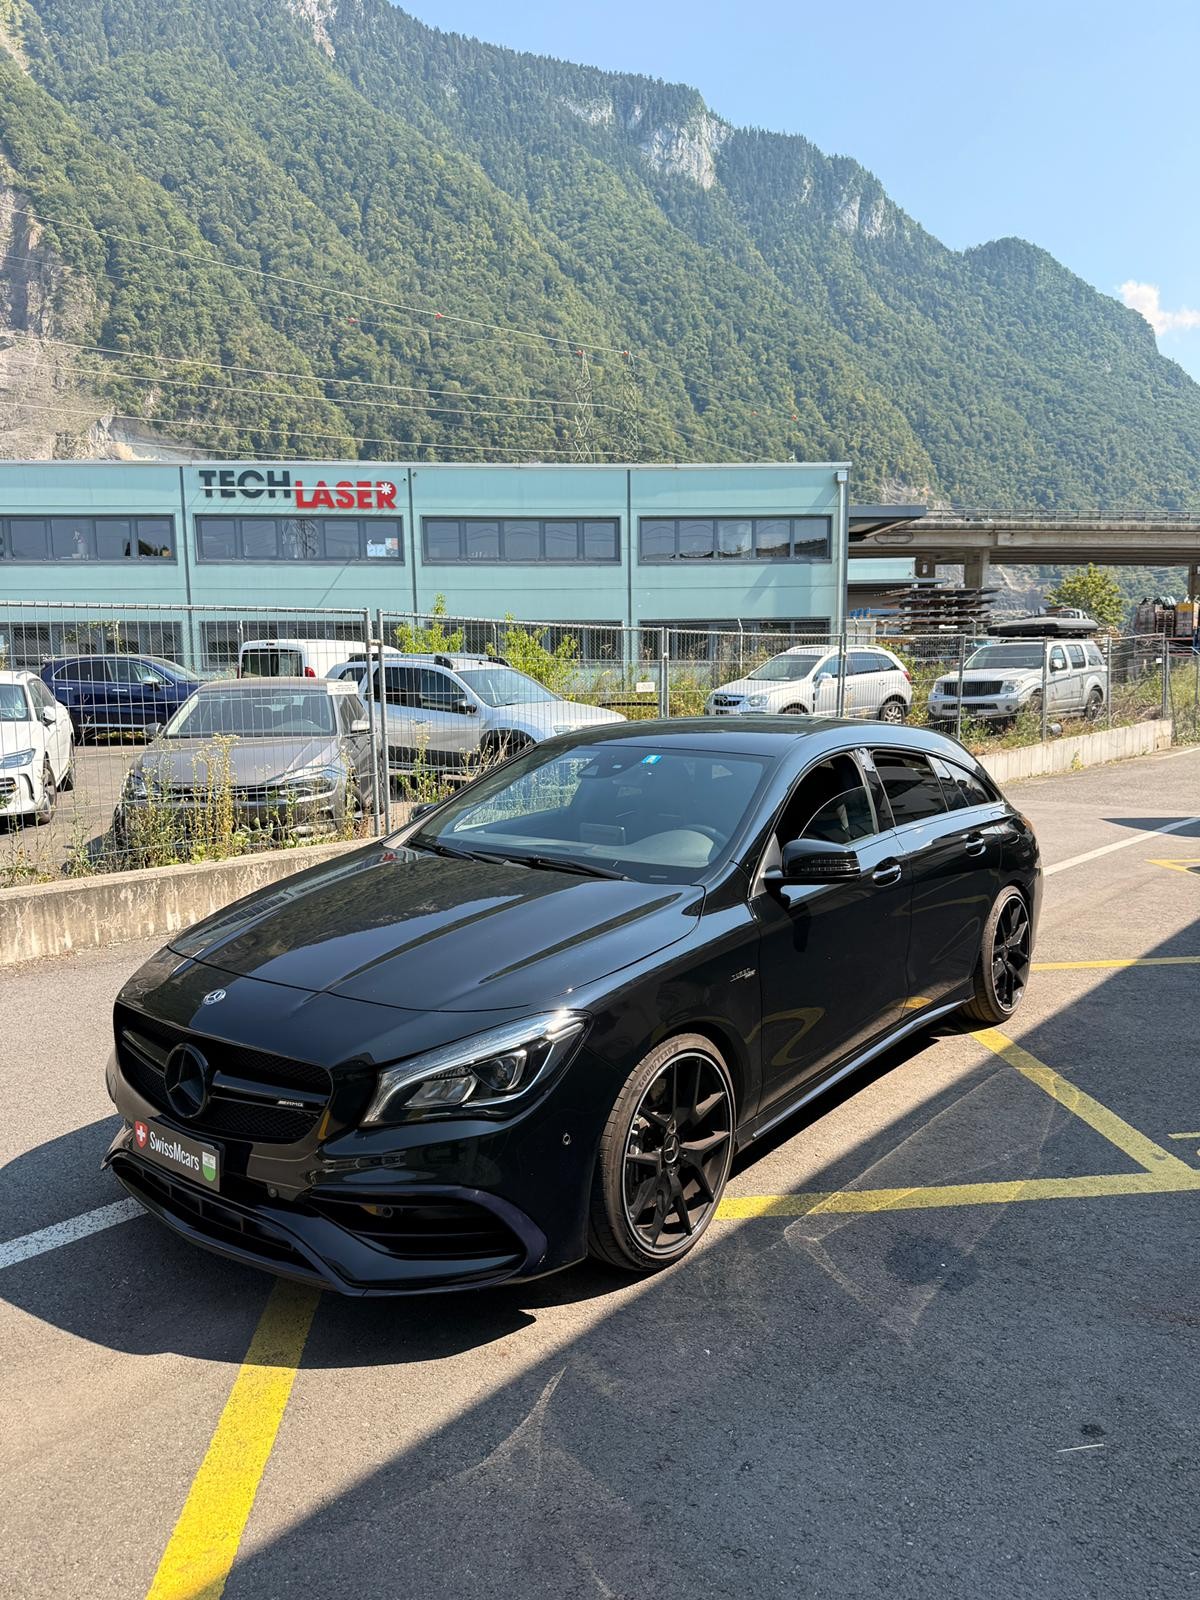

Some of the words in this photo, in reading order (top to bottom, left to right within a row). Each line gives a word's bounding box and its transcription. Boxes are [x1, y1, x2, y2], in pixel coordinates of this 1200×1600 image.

[199, 470, 291, 498] TECH
[295, 480, 397, 509] LASER
[149, 1131, 200, 1170] SwissMcars
